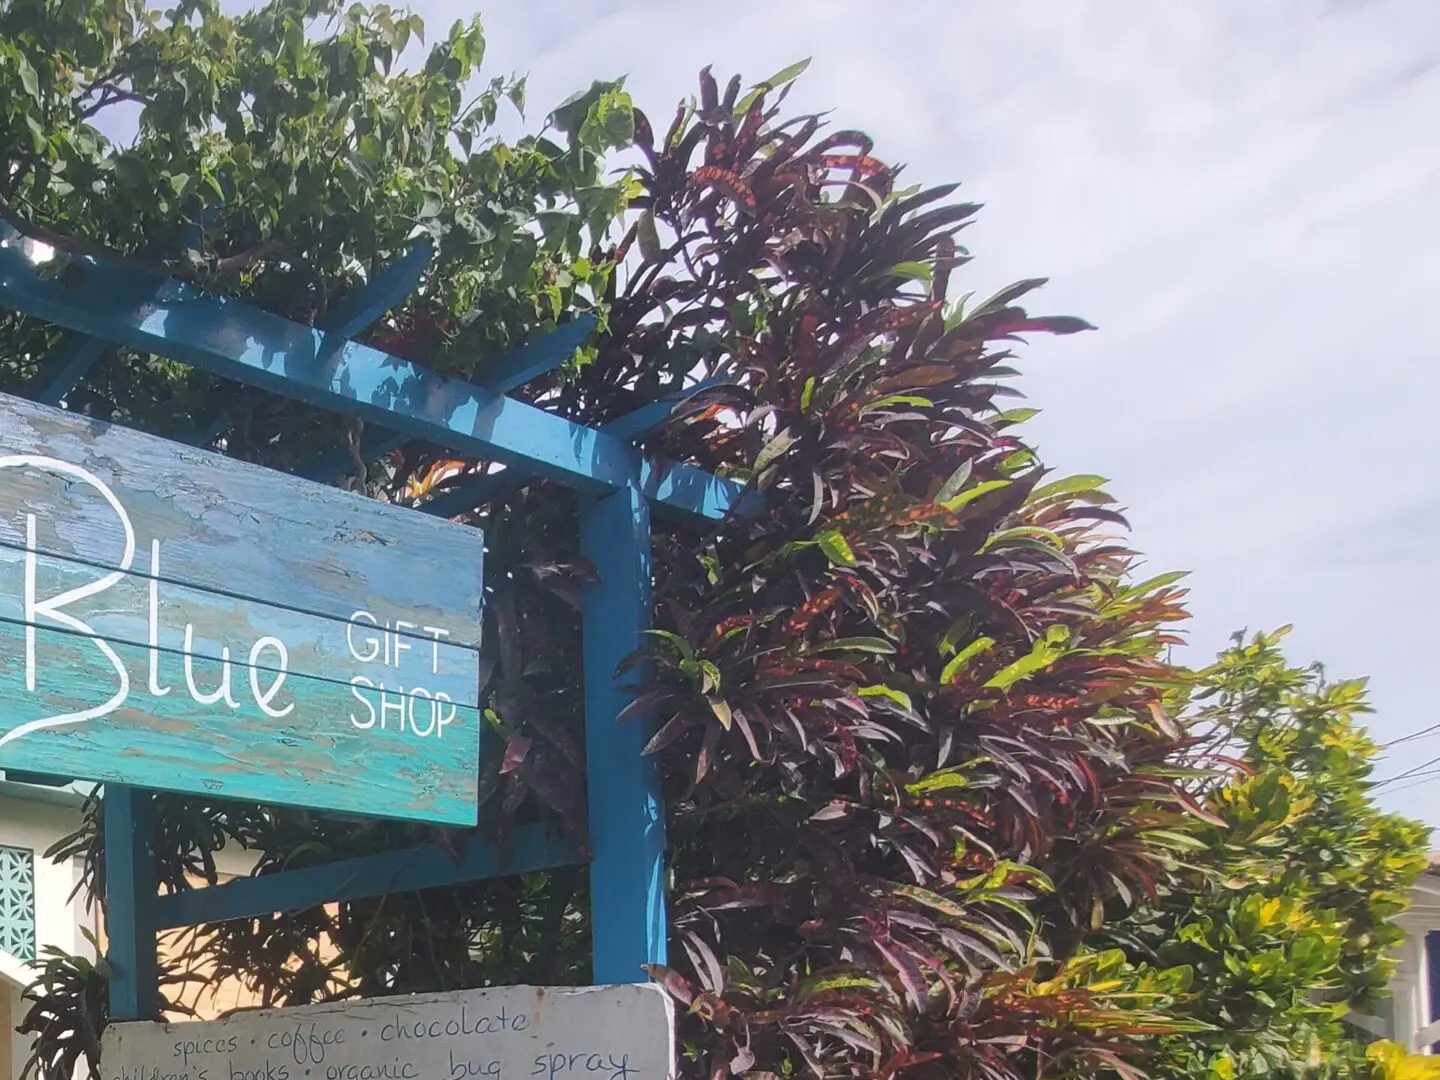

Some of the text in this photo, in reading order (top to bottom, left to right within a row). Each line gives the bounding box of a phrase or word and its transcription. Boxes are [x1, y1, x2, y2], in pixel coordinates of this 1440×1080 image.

[346, 610, 450, 675] GIFT
[349, 675, 457, 739] SHOP
[173, 1006, 530, 1067] spices coffee chocolate
